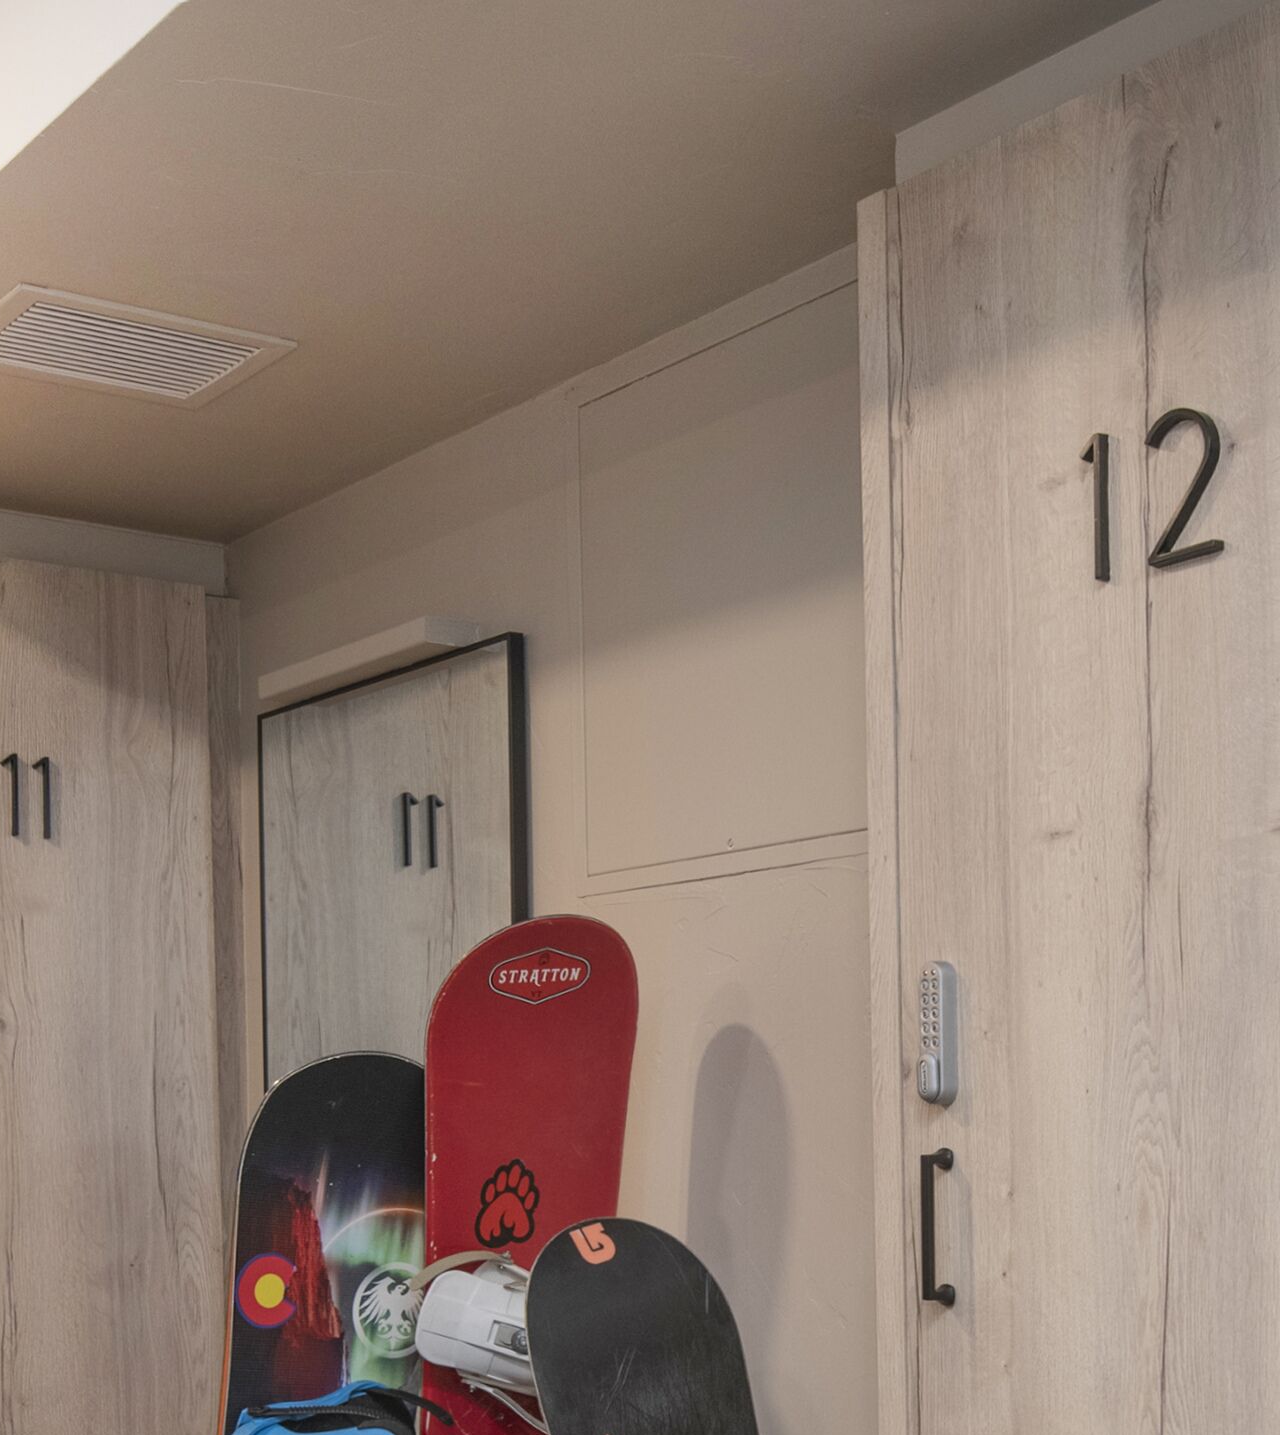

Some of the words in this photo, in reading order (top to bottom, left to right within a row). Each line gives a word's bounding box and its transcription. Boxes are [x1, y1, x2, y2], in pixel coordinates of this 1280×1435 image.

[1080, 408, 1225, 583] 12
[0, 753, 51, 839] 11
[498, 966, 582, 987] STRATTON
